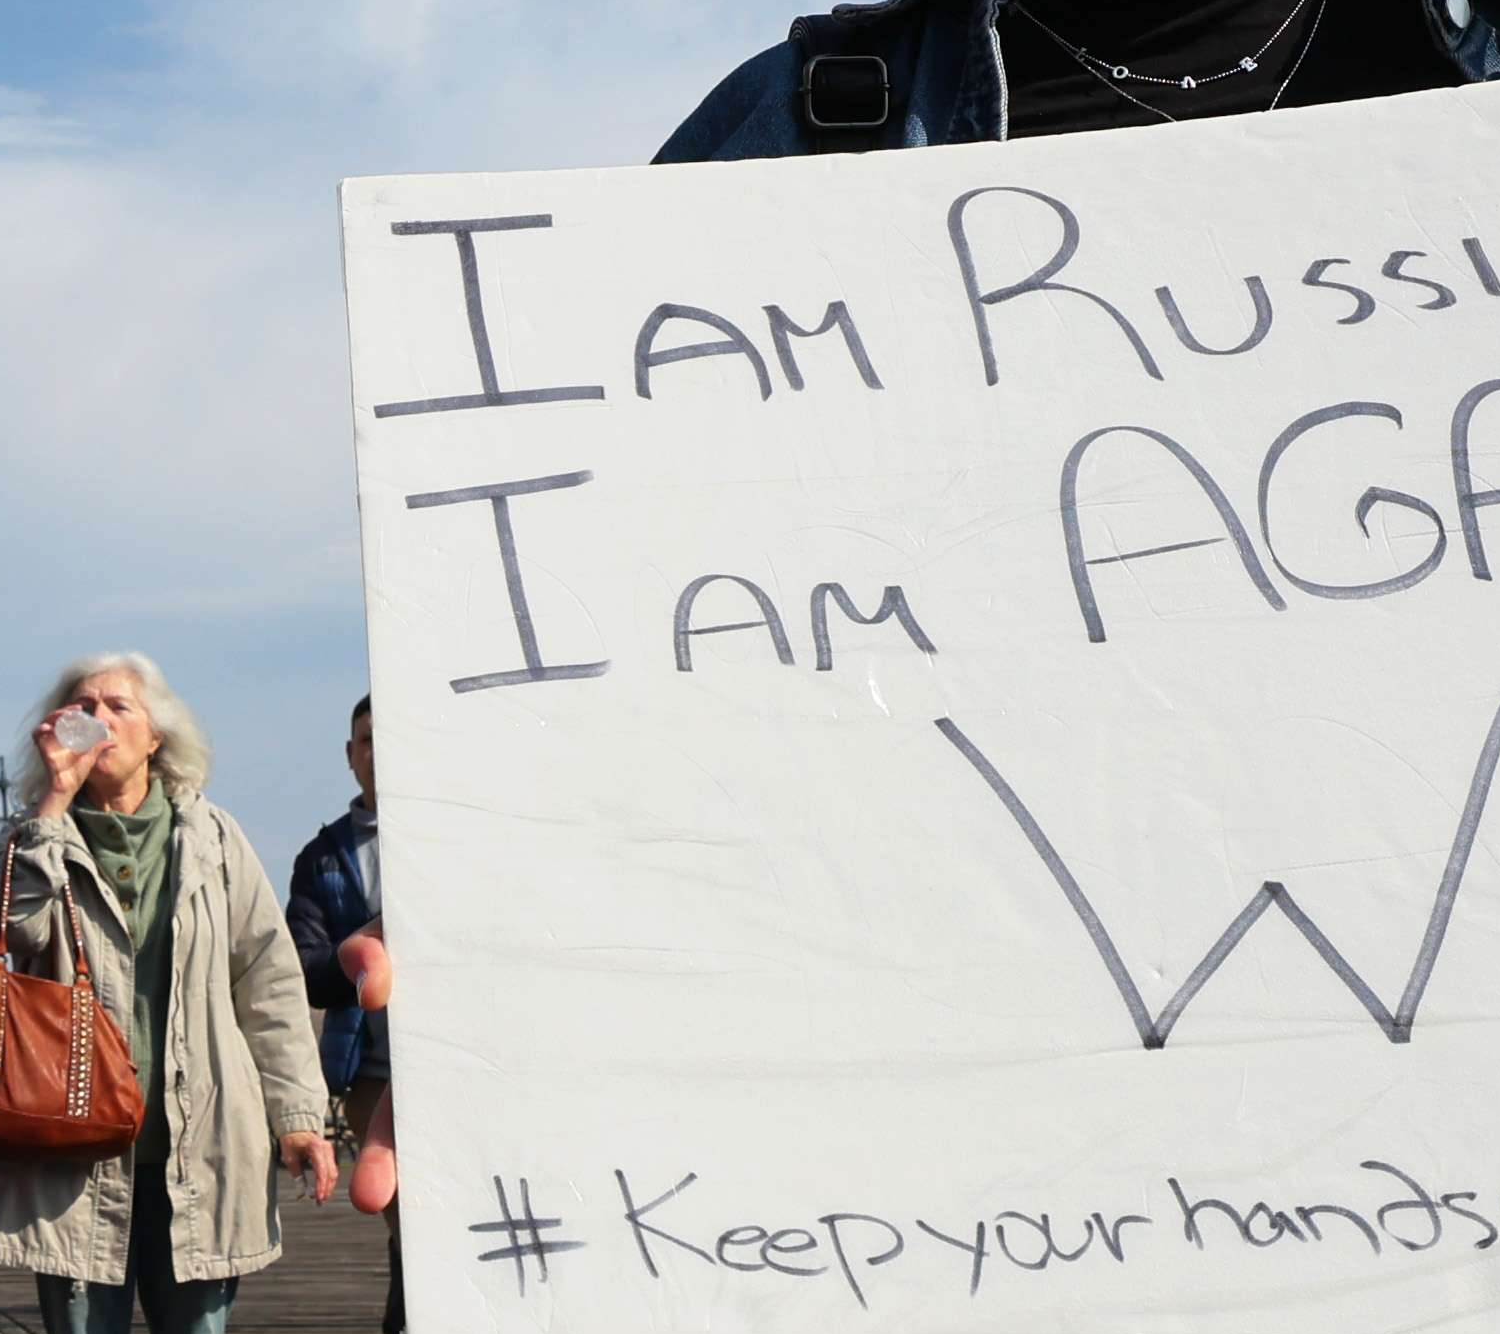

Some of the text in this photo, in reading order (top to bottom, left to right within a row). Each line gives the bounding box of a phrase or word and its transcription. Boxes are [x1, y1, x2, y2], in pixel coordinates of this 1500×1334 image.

[374, 214, 605, 418] I
[634, 301, 884, 401] AM
[405, 471, 608, 694] I
[674, 575, 937, 672] AM
